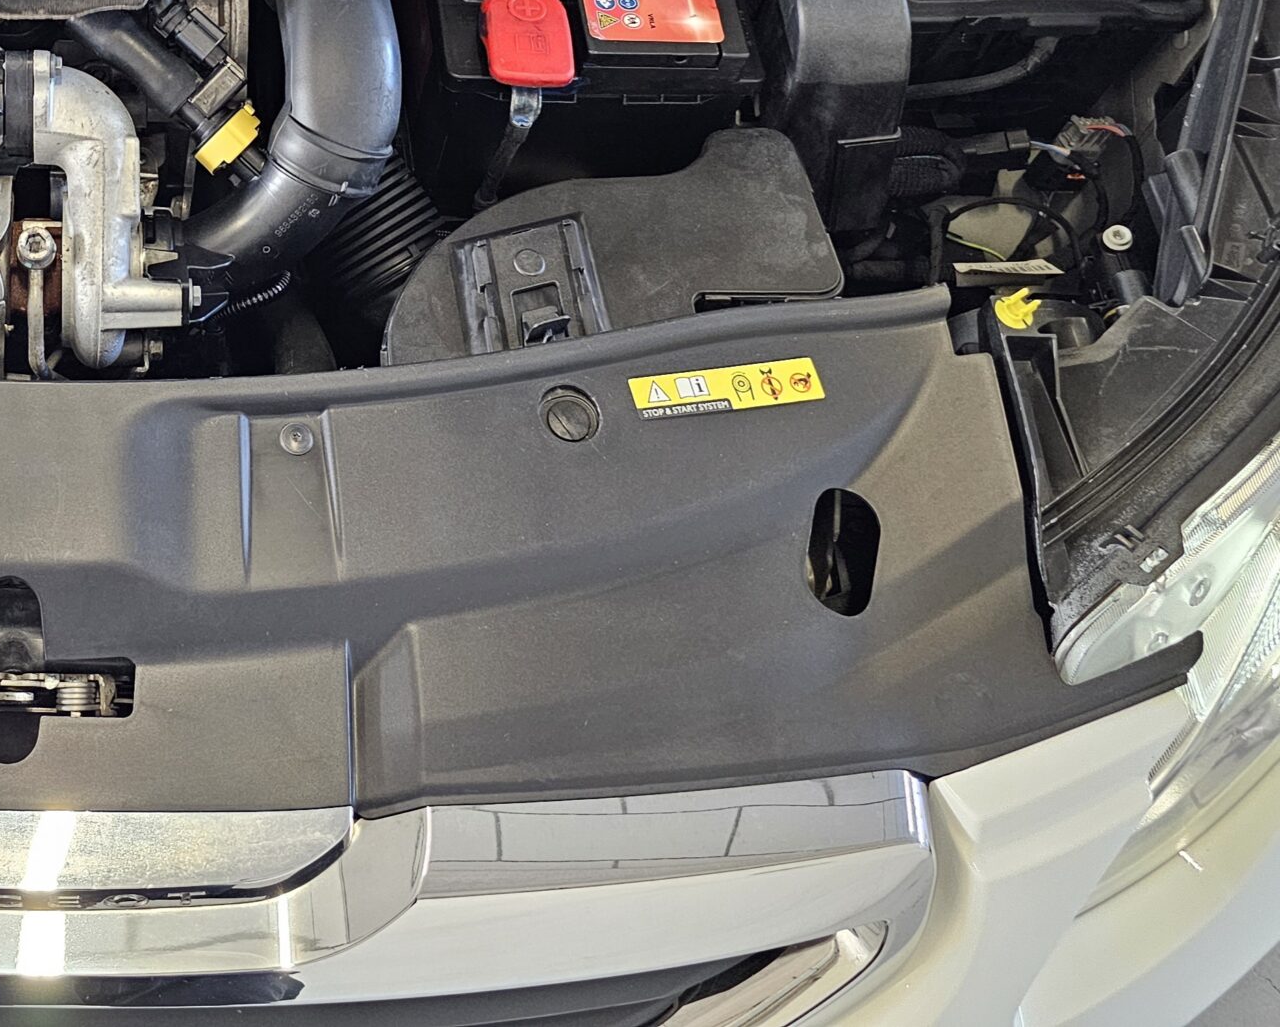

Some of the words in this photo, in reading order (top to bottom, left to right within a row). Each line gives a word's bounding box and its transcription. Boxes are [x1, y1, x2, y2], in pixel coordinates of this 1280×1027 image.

[642, 408, 665, 418] STOP
[664, 408, 672, 416] &
[672, 404, 698, 415] START
[698, 400, 730, 412] SYSTEM
